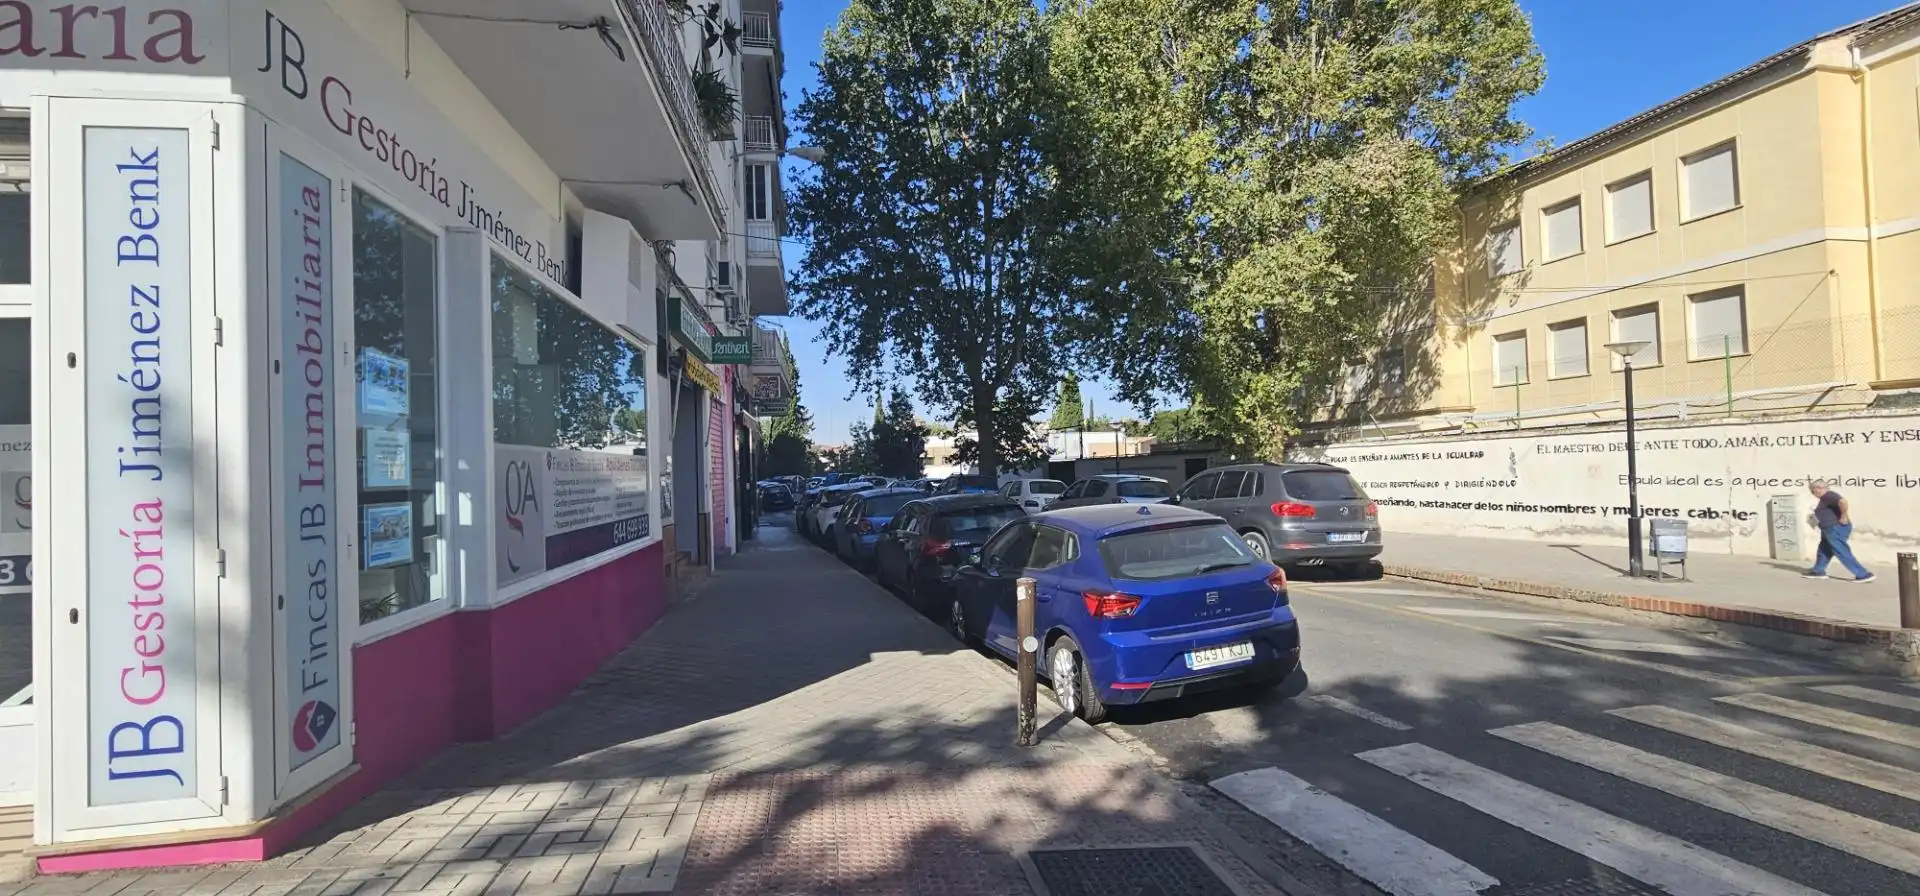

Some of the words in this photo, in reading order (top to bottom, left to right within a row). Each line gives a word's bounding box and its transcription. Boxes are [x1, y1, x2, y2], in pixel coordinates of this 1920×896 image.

[257, 8, 308, 100] JB
[320, 76, 451, 208] Gestoría
[457, 181, 532, 263] Jiménez
[536, 240, 569, 288] Benk
[116, 145, 160, 267] Benk
[118, 283, 163, 481] Jiménez
[294, 185, 325, 492] Inmobiliaria
[1432, 452, 1442, 460] LA
[1537, 444, 1551, 454] EL
[1553, 443, 1605, 454] MAESTRO
[1644, 439, 1679, 450] ANTE
[1861, 430, 1875, 443] Y
[1666, 474, 1699, 486] ideal
[1704, 477, 1723, 486] es
[1746, 477, 1778, 490] que
[1845, 475, 1887, 487] aire
[1896, 473, 1920, 488] lib
[300, 503, 327, 548] JB
[1420, 500, 1445, 509] hasta
[1446, 501, 1473, 510] hacer
[1474, 501, 1487, 511] de
[1488, 502, 1503, 511] los
[1506, 501, 1538, 513] niños
[1540, 504, 1597, 514] hombres
[1601, 506, 1608, 517] y
[119, 496, 166, 706] Gestoría
[301, 559, 329, 695] Fincas
[108, 714, 185, 787] JB
